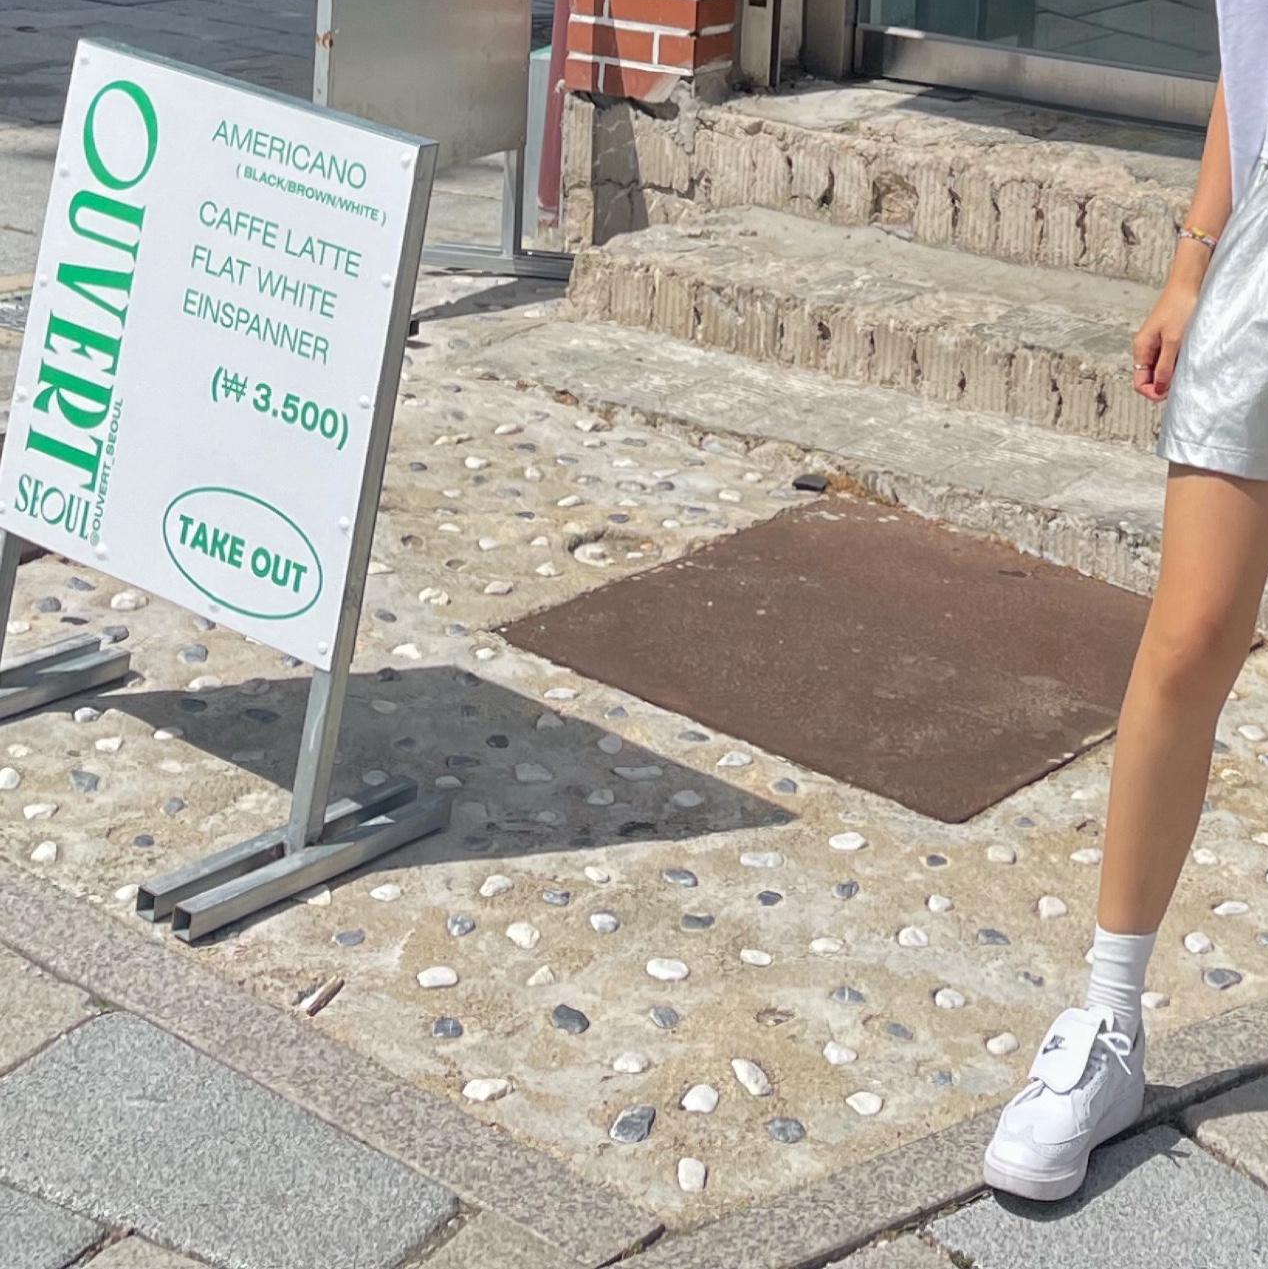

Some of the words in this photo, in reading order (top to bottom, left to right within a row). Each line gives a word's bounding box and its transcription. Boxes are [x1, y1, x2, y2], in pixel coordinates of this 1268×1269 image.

[212, 120, 367, 189] AMERICANO
[199, 200, 279, 249] CAFFE
[284, 229, 362, 278] LATTE
[25, 79, 158, 493] OUVERT
[191, 244, 251, 285] FLAT
[258, 266, 337, 319] WHITE
[183, 288, 330, 365] EINSPANNER
[14, 473, 90, 540] SEOUL
[178, 514, 245, 569] TAKE
[250, 547, 308, 594] OUT
